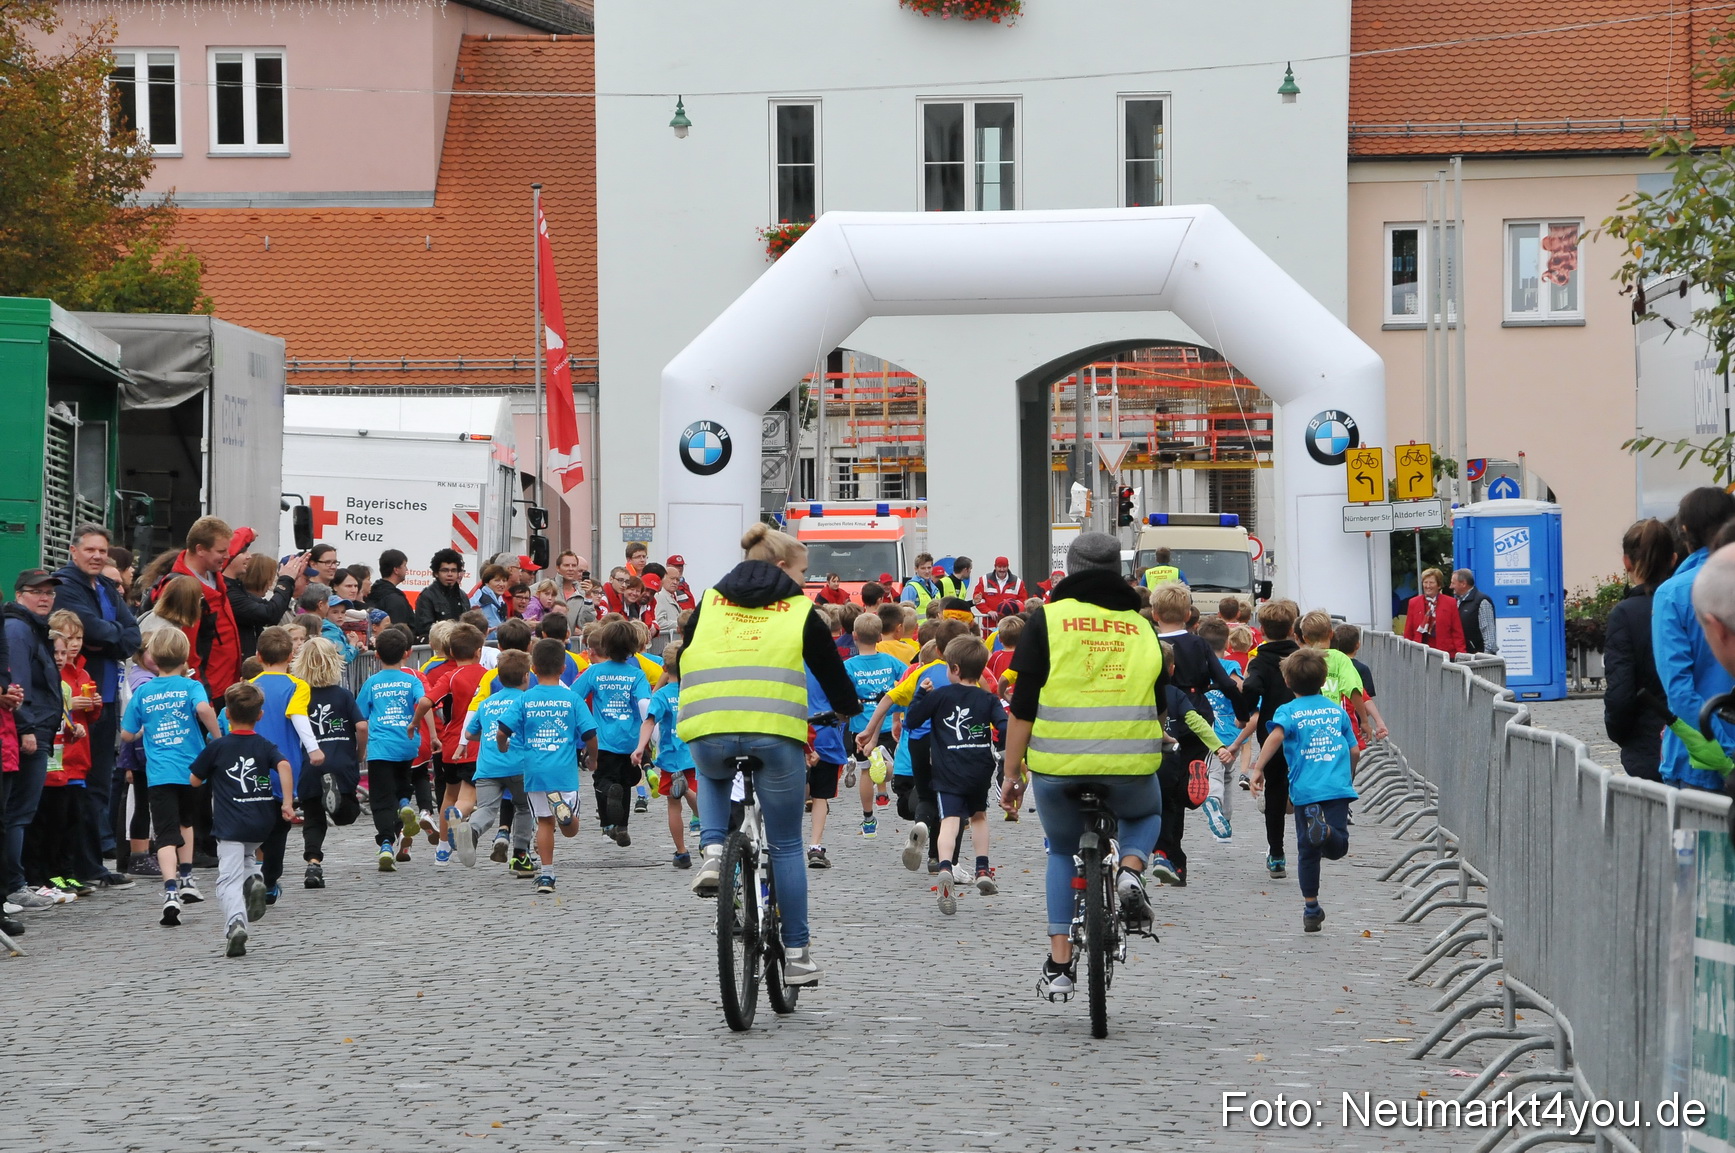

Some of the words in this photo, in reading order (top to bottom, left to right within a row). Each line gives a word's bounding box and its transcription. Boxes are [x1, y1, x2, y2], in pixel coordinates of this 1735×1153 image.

[1309, 411, 1356, 431] BMW
[683, 421, 729, 441] BMW
[762, 422, 776, 432] 30
[346, 497, 428, 511] Bayerisches
[1344, 515, 1380, 523] Nürnberger
[1394, 510, 1426, 519] Altdorfer
[1427, 508, 1441, 518] Str.
[346, 514, 384, 525] Rotes
[345, 530, 384, 542] Kreuz
[725, 612, 769, 620] NEUMARKTER
[1062, 617, 1140, 635] HELFER
[1081, 639, 1125, 647] NEUMARKTER
[371, 681, 412, 692] NEUMARKTER
[598, 683, 632, 691] STADTLAU
[142, 690, 188, 705] NEUMARKTER
[374, 690, 409, 700] STADTLAUF
[145, 700, 186, 714] STADTLAUF
[524, 700, 572, 709] NEUMARKTER
[171, 709, 190, 721] 2014
[526, 710, 569, 718] STADTLAUF
[1290, 707, 1342, 720] NEUMARKTER
[554, 717, 569, 731] 2014
[1297, 716, 1340, 730] STADTLAUF
[175, 728, 190, 736] LAUF
[1326, 725, 1343, 738] 2014
[1327, 743, 1343, 752] LAUF
